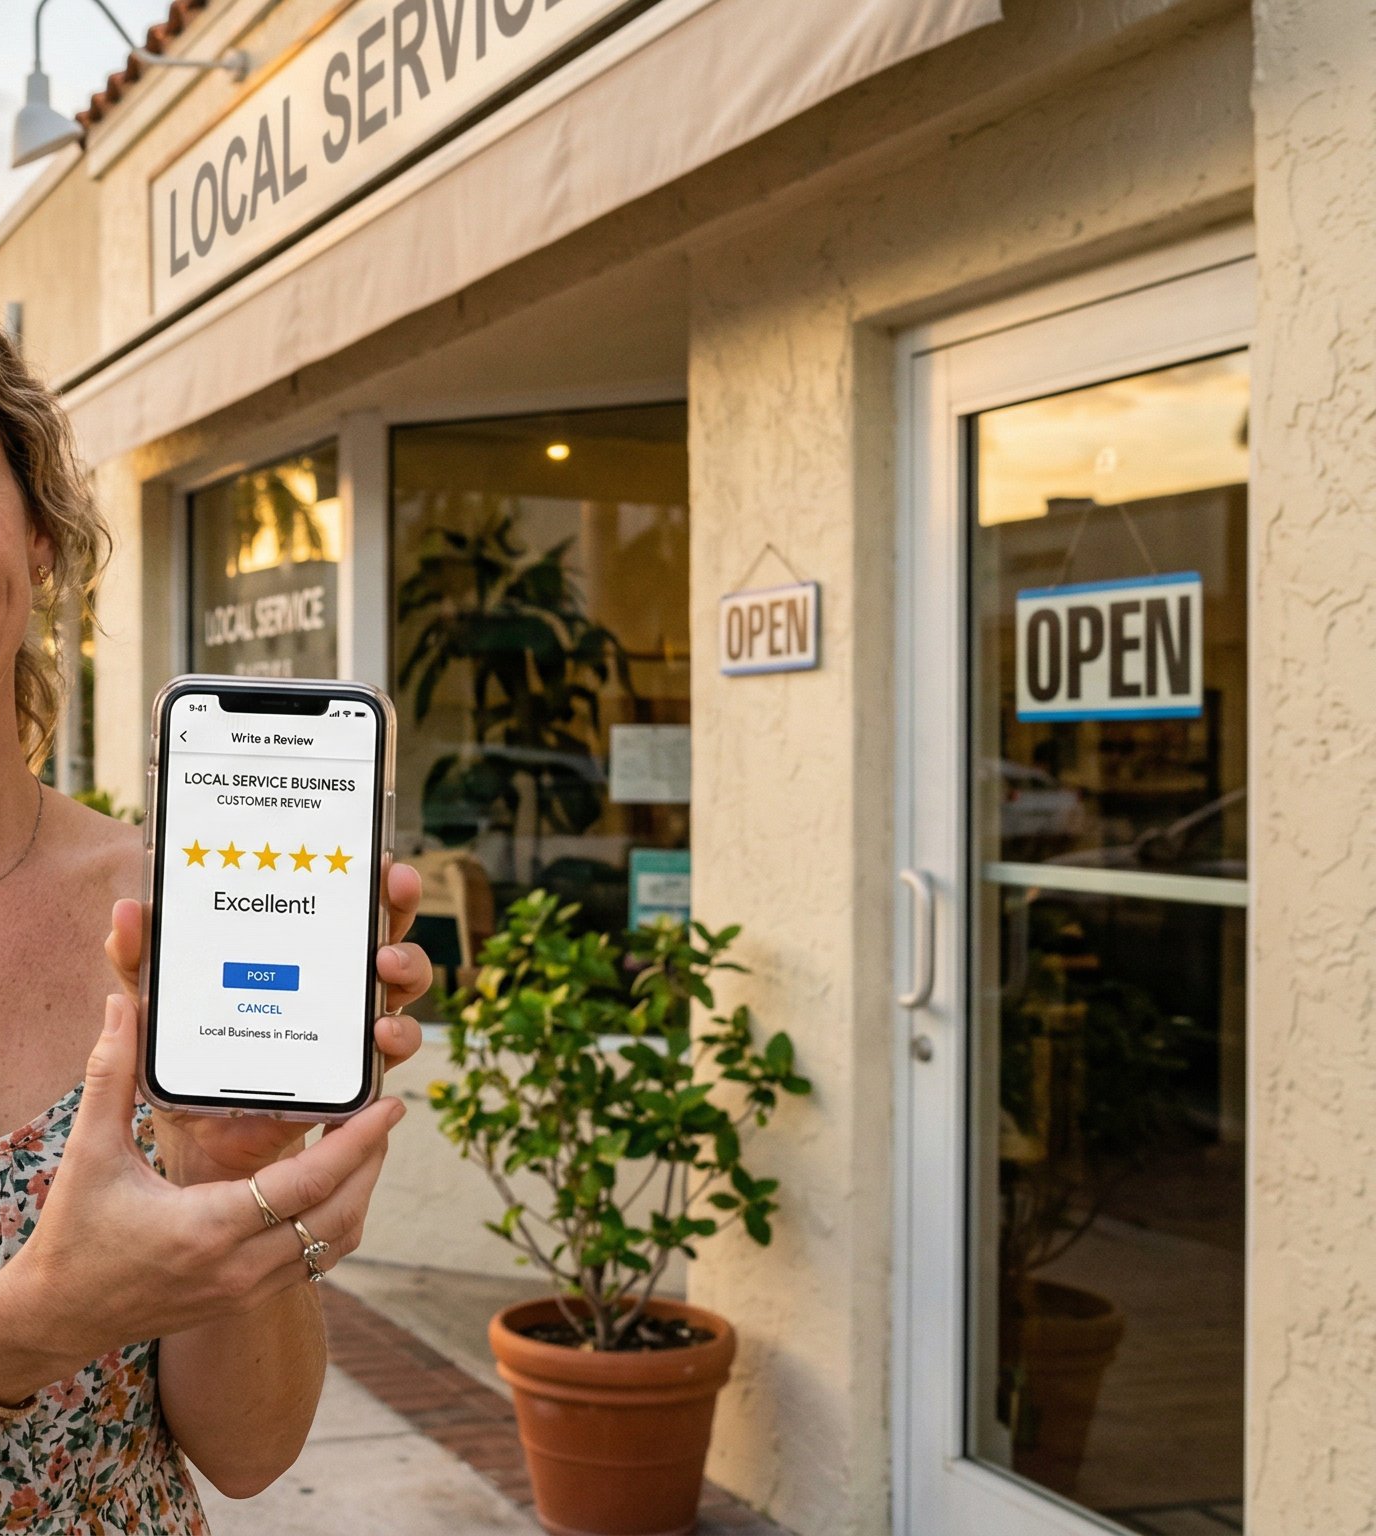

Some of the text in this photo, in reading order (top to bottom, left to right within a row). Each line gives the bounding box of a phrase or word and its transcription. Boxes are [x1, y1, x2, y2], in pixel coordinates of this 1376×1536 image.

[169, 0, 563, 279] LOCAL SERVI
[255, 585, 324, 639] SERVICE
[726, 595, 809, 662] OPEN
[1025, 594, 1192, 704] OPEN
[231, 732, 314, 746] Write a Review
[184, 772, 356, 792] LOCAL SERVICE BUSINESS
[216, 795, 322, 809] CUSTOMER REVIEW
[213, 891, 316, 915] Excellent!
[247, 971, 276, 982] POST
[237, 1003, 283, 1015] CANCEL
[199, 1025, 319, 1041] Local Business in Florida
